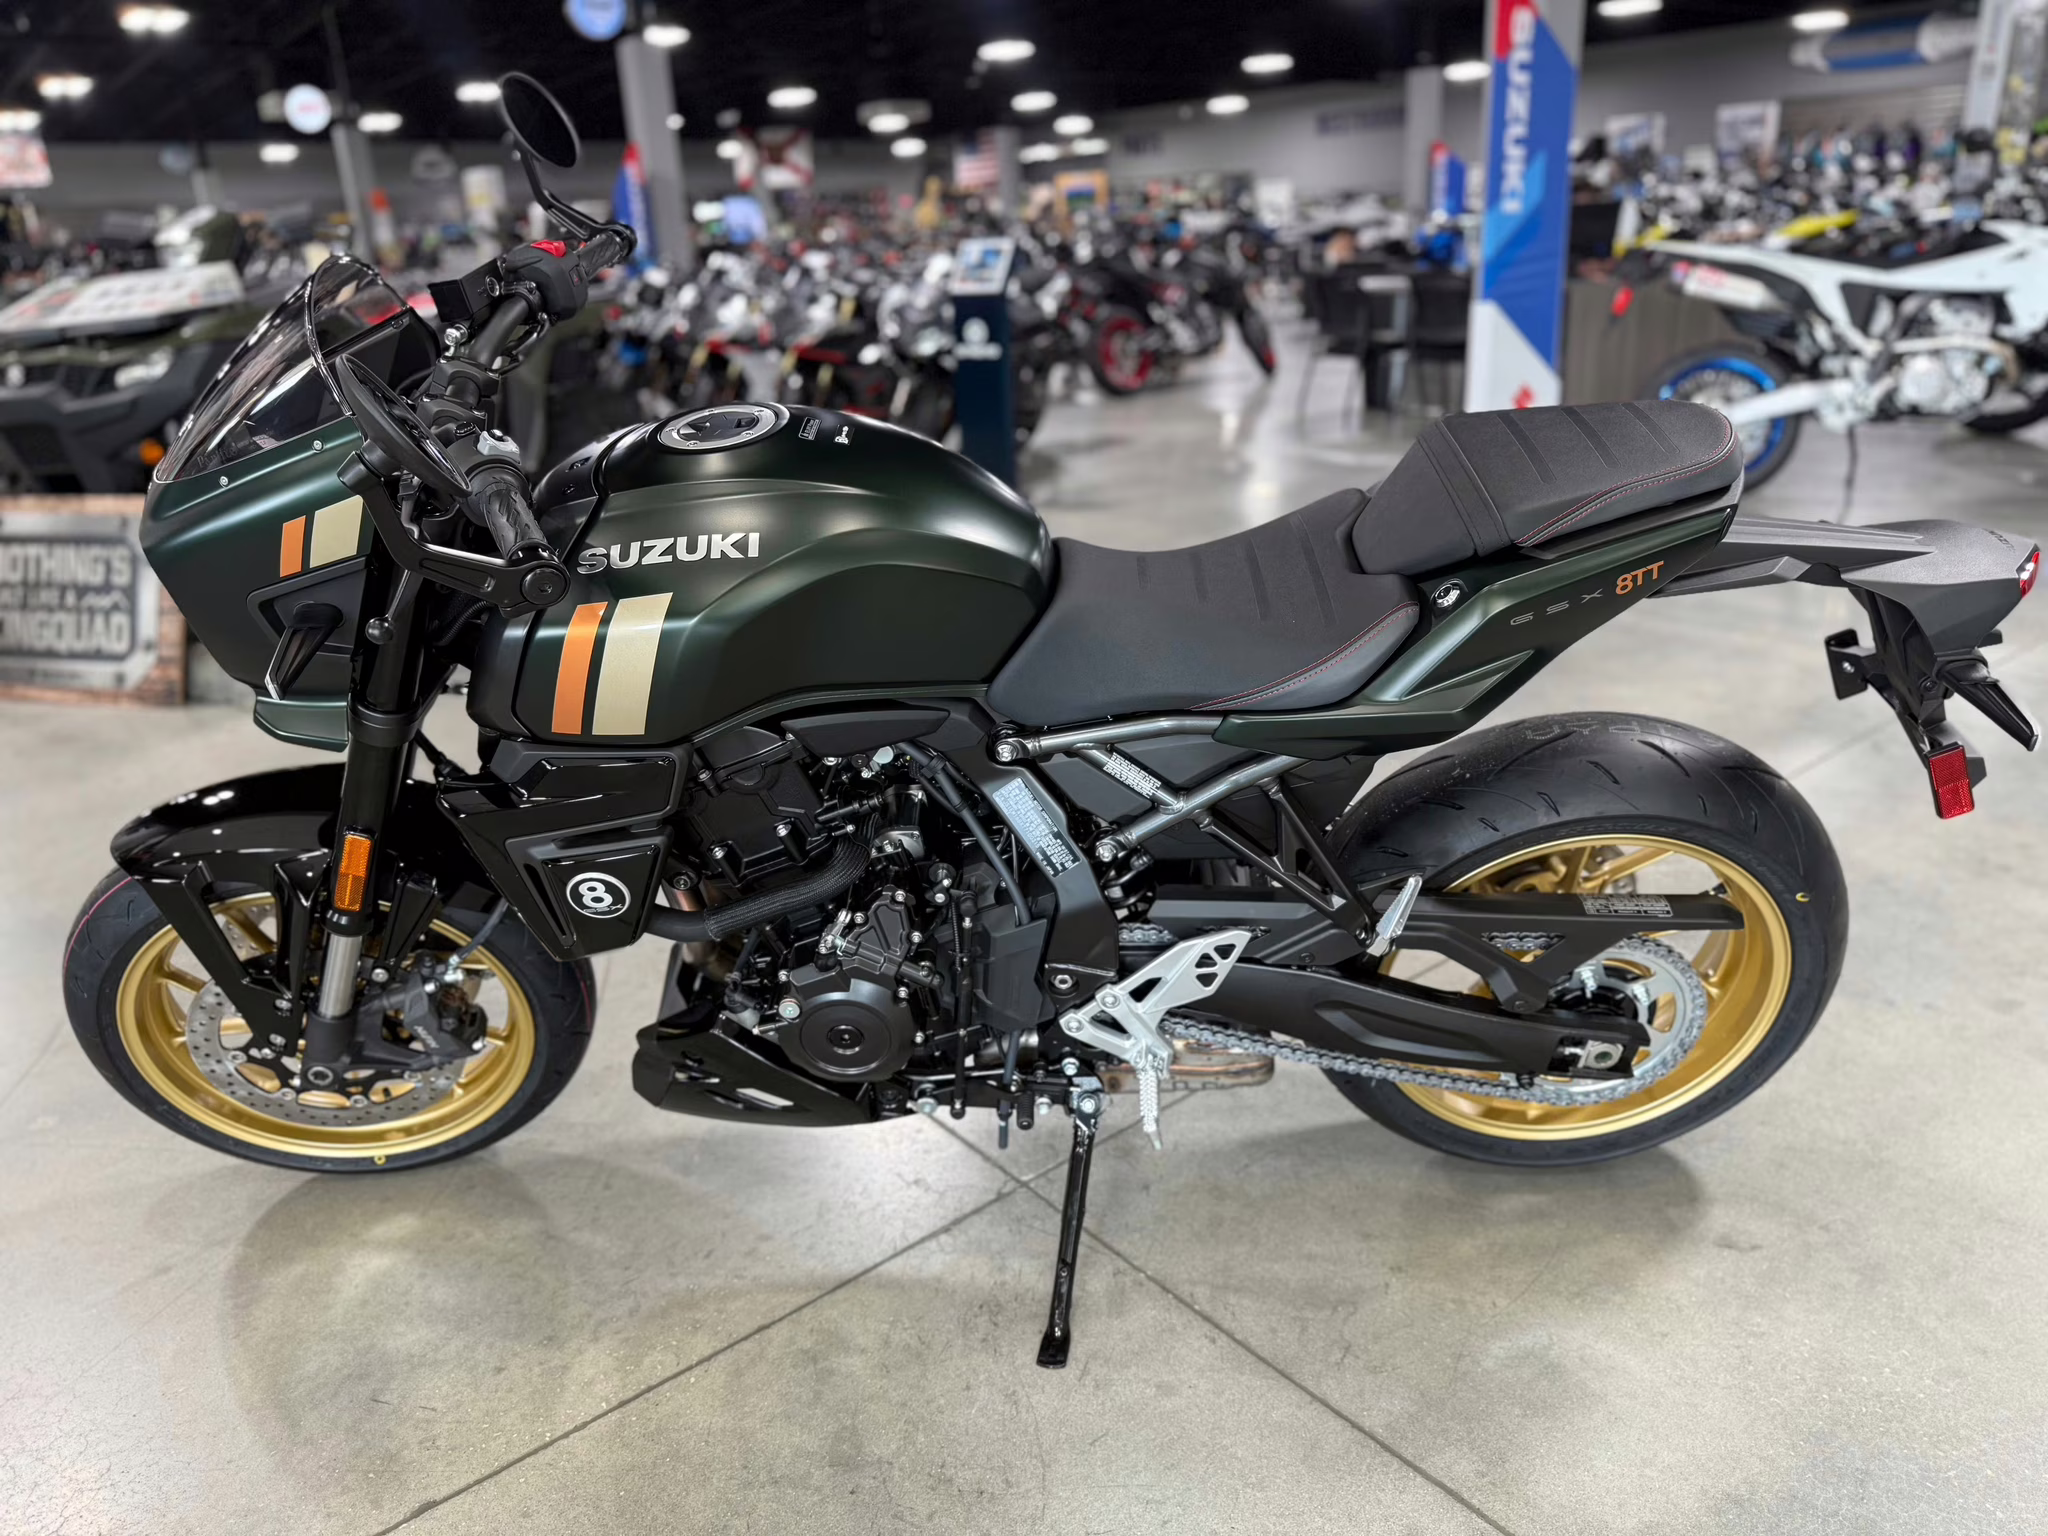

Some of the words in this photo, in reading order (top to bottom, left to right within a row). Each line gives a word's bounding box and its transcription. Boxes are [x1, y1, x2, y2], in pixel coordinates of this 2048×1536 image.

[1501, 5, 1536, 215] SUZUKI
[576, 532, 760, 575] SUZUKI
[1615, 560, 1664, 595] 8TT
[0, 610, 131, 656] INGQUAD
[578, 881, 613, 908] 8
